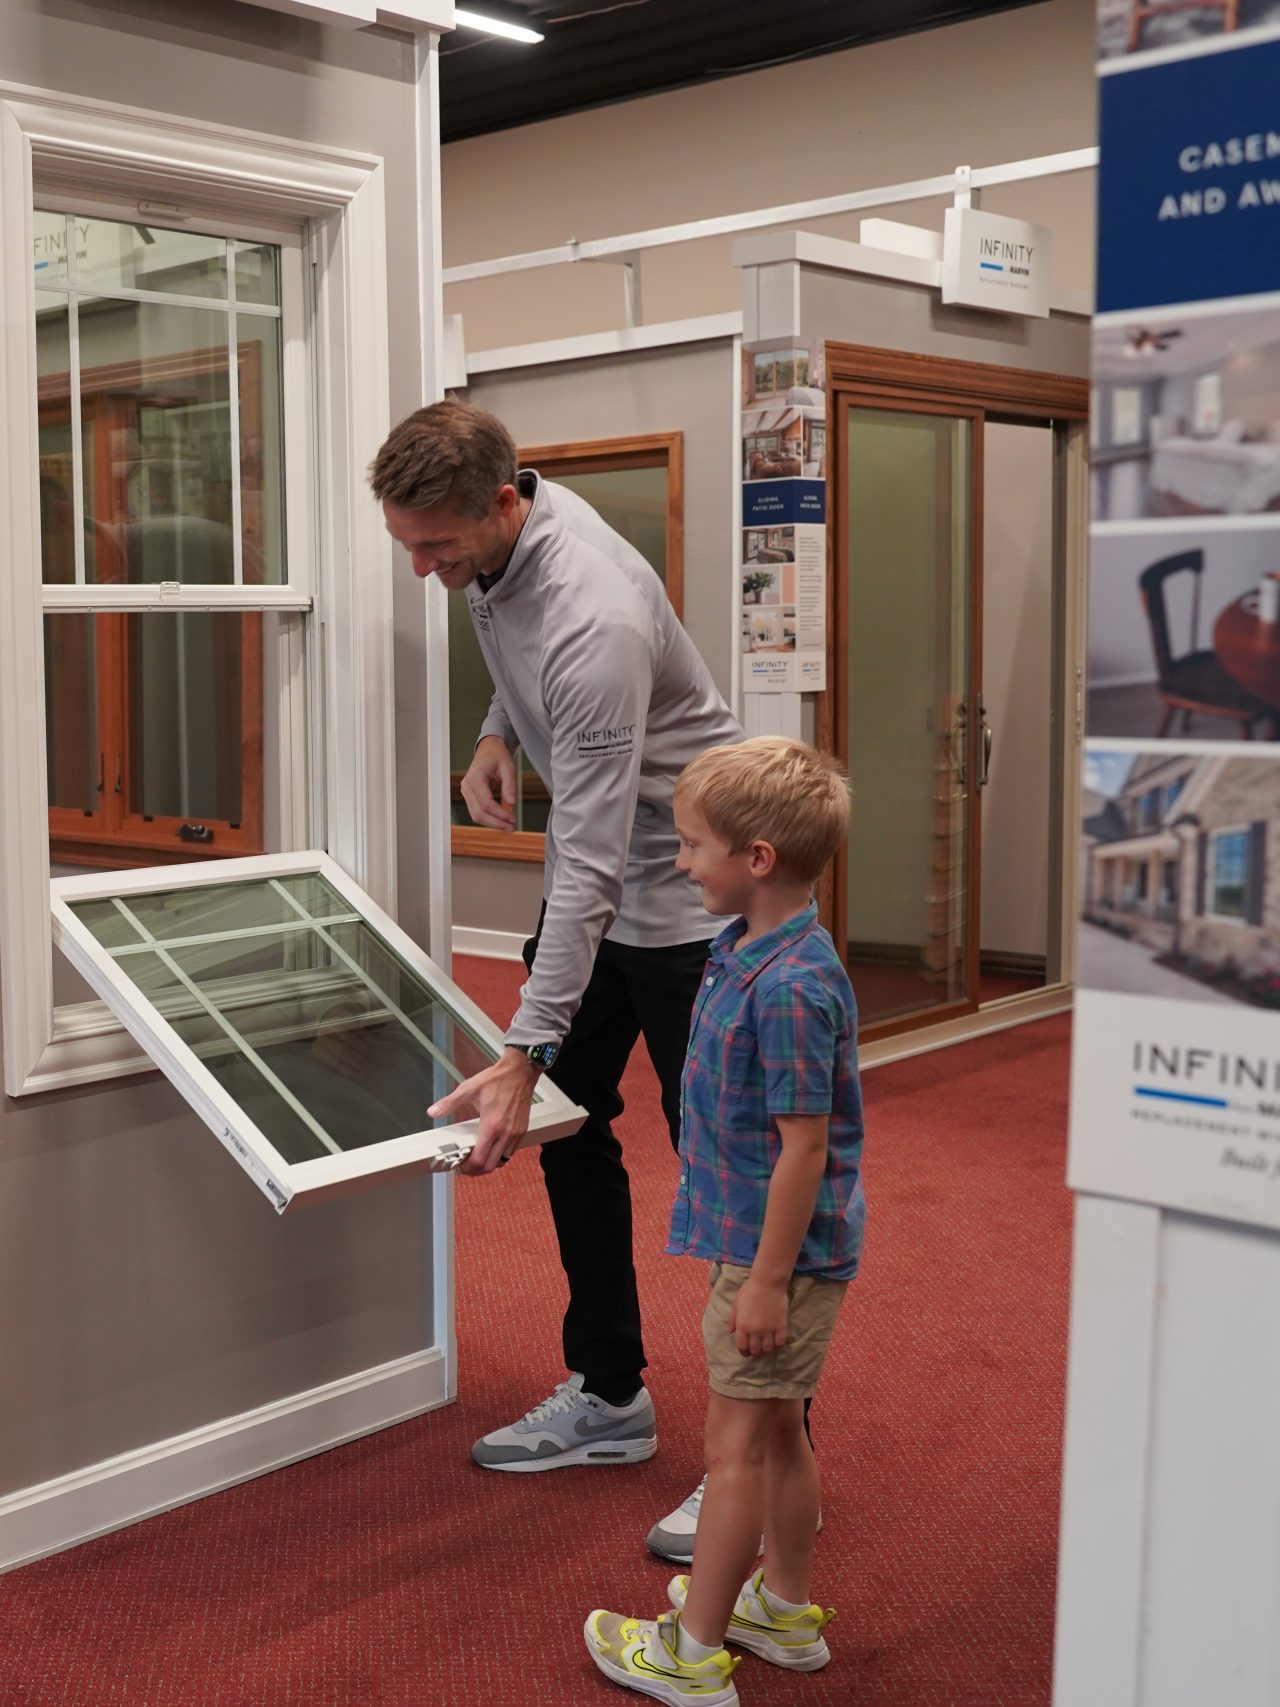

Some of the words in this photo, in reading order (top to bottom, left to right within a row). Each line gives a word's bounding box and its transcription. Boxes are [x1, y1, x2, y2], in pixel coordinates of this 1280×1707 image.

[1178, 131, 1280, 173] CASEM
[1157, 187, 1227, 222] AND
[1237, 178, 1280, 210] AW
[979, 237, 1034, 263] INFINITY
[1009, 266, 1030, 277] MARVIN
[751, 660, 789, 669] INFINITY
[577, 724, 635, 743] INFINITY
[1132, 1040, 1280, 1095] INFINI
